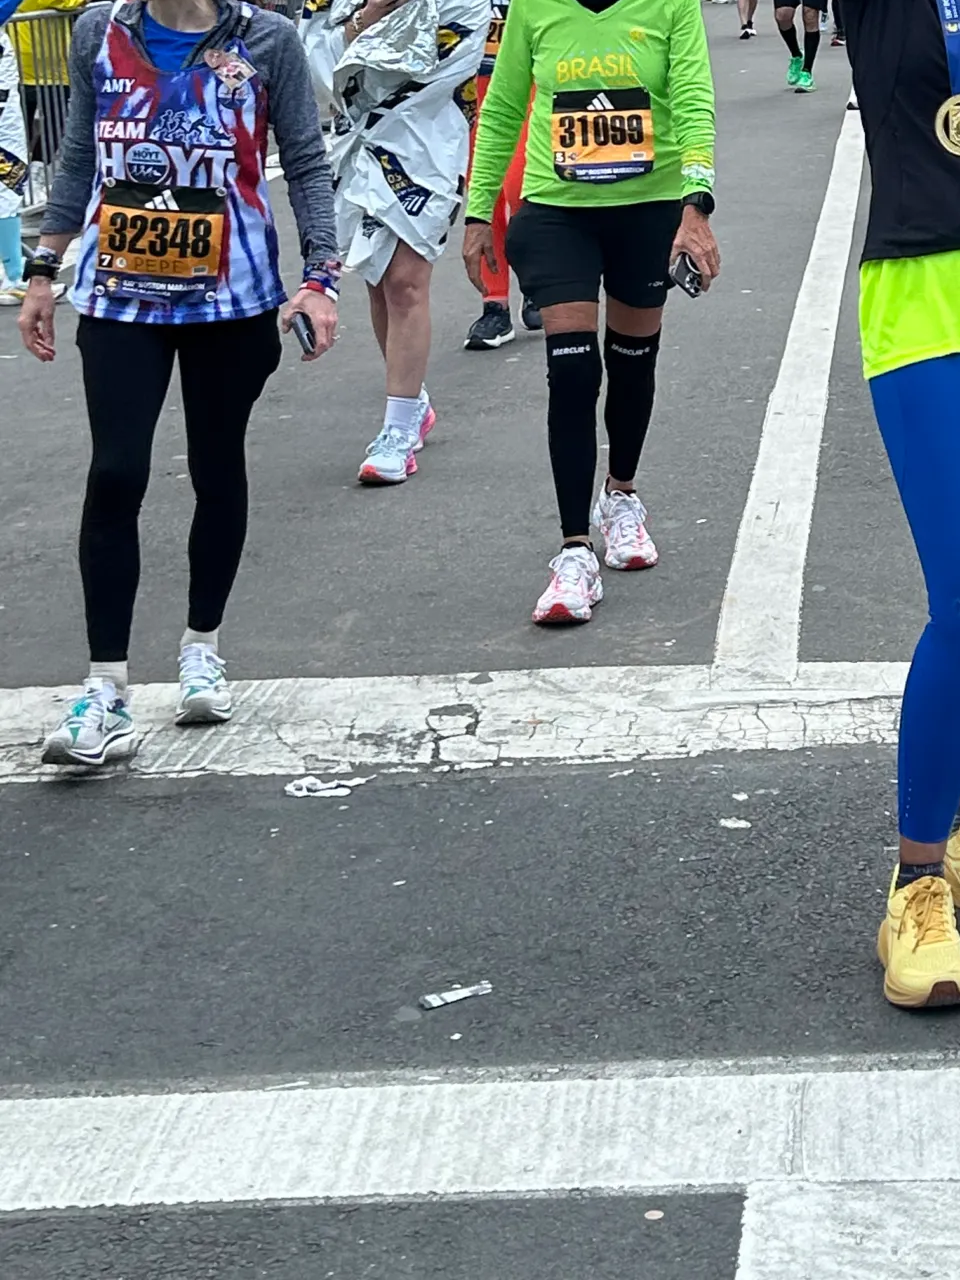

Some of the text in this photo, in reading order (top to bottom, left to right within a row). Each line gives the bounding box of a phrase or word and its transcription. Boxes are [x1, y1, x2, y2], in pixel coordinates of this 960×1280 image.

[556, 53, 638, 83] BRASIL
[102, 78, 135, 93] AMY
[98, 121, 146, 140] TEAM
[558, 114, 645, 148] 31099
[108, 212, 212, 258] 32348
[100, 254, 184, 273] 7 PEPE
